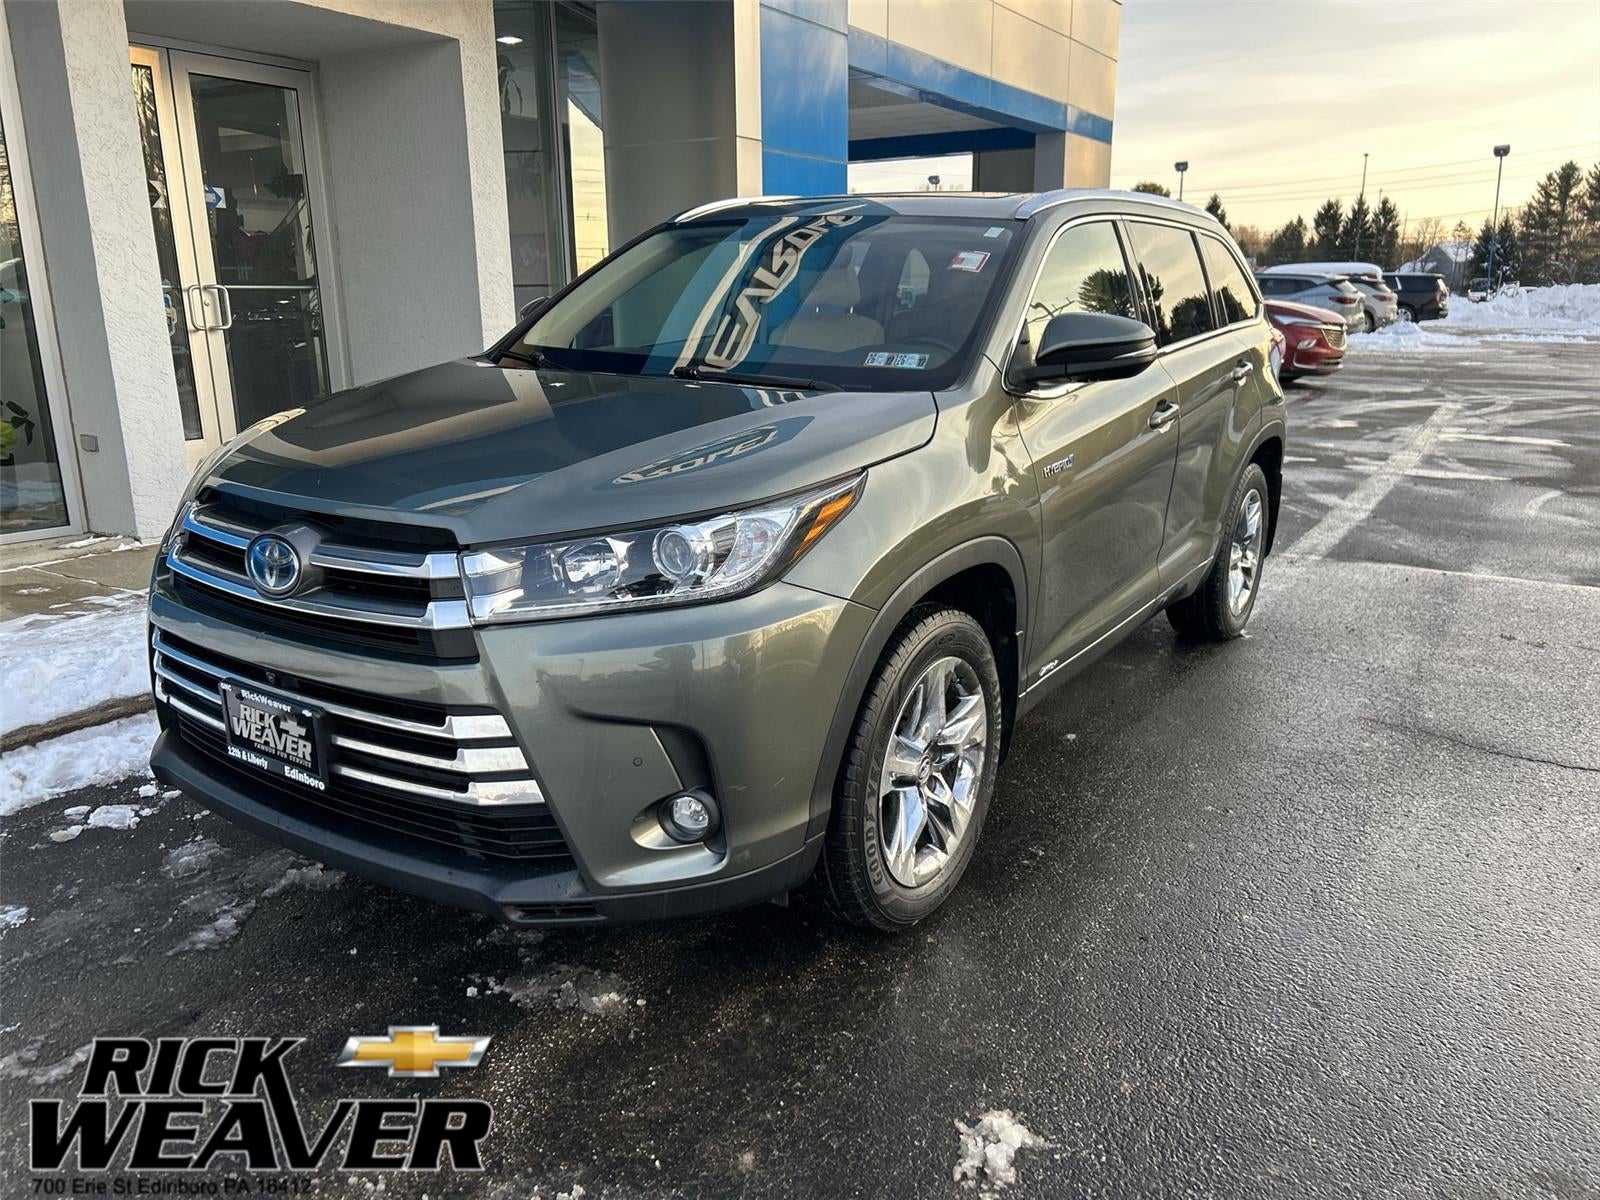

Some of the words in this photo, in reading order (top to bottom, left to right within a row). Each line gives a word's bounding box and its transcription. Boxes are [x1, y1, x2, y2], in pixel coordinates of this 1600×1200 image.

[240, 704, 276, 728] RICK
[232, 716, 312, 762] WEAVER
[284, 765, 325, 791] Edinboro
